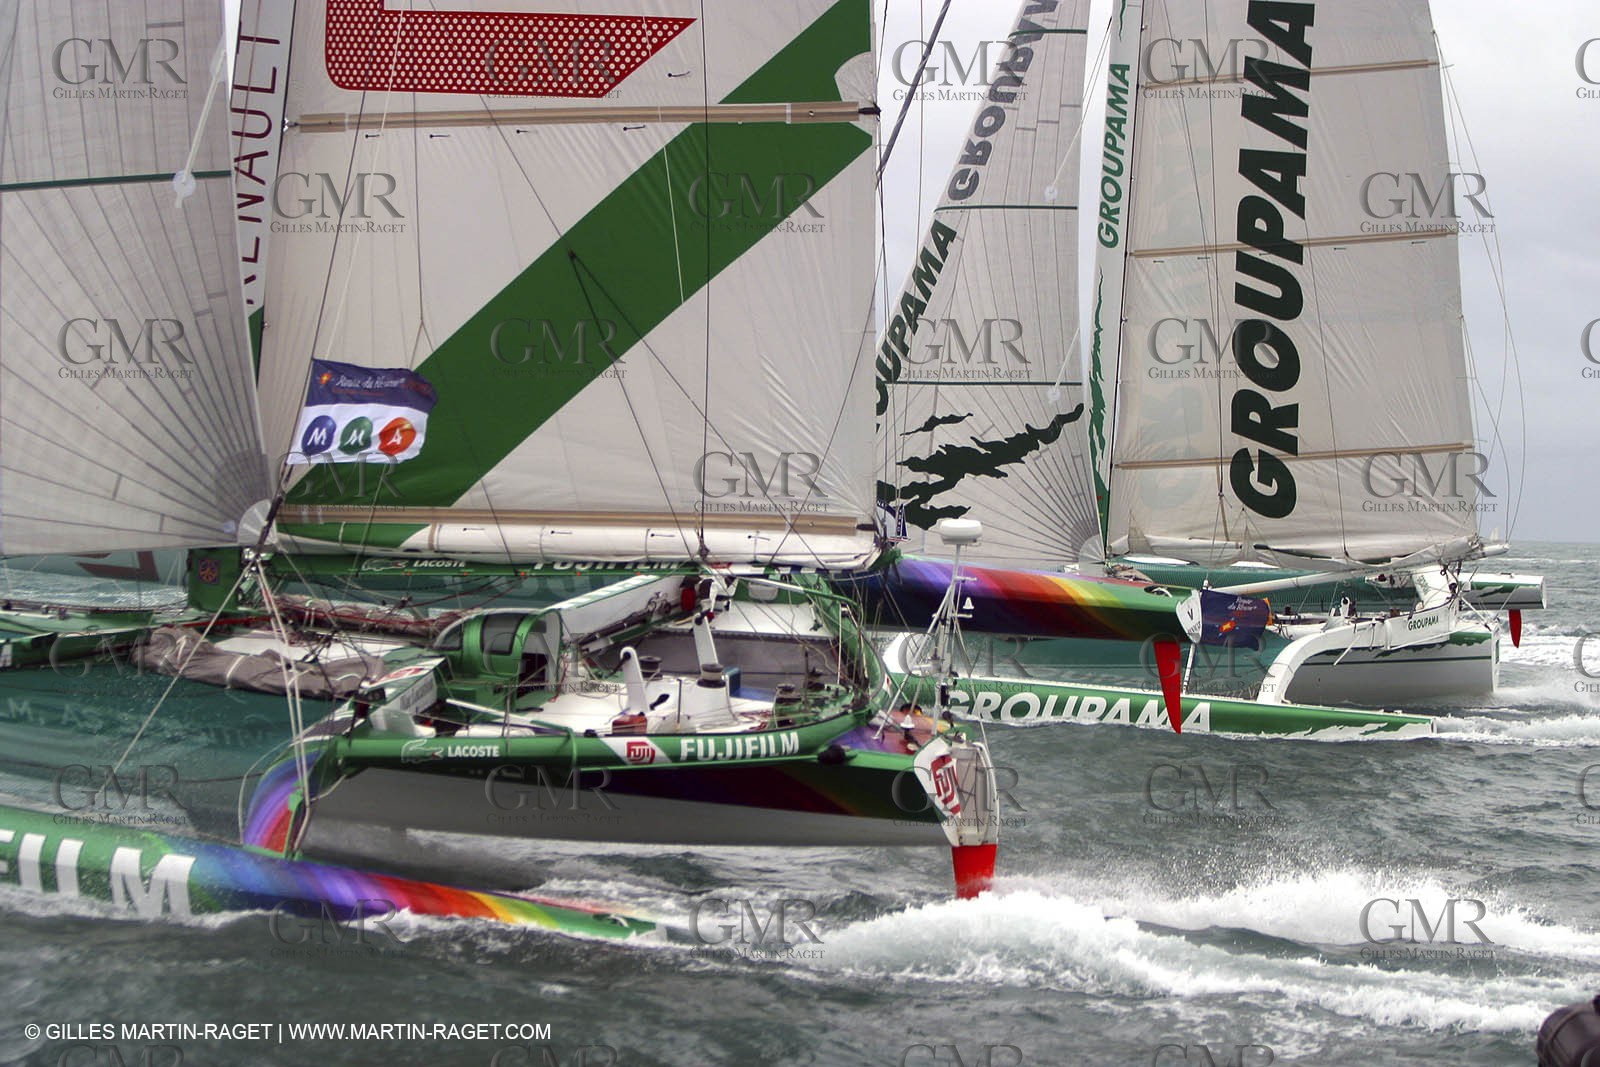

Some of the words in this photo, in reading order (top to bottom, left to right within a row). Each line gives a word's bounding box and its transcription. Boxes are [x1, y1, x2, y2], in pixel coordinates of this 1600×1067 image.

[1098, 63, 1130, 249] GROUPAMA
[1229, 0, 1315, 519] GROUPAMA
[413, 559, 466, 568] LACOSTE
[1407, 615, 1440, 631] GROUPAMA
[447, 744, 499, 758] LACOSTE
[679, 731, 800, 762] FUJIFILM
